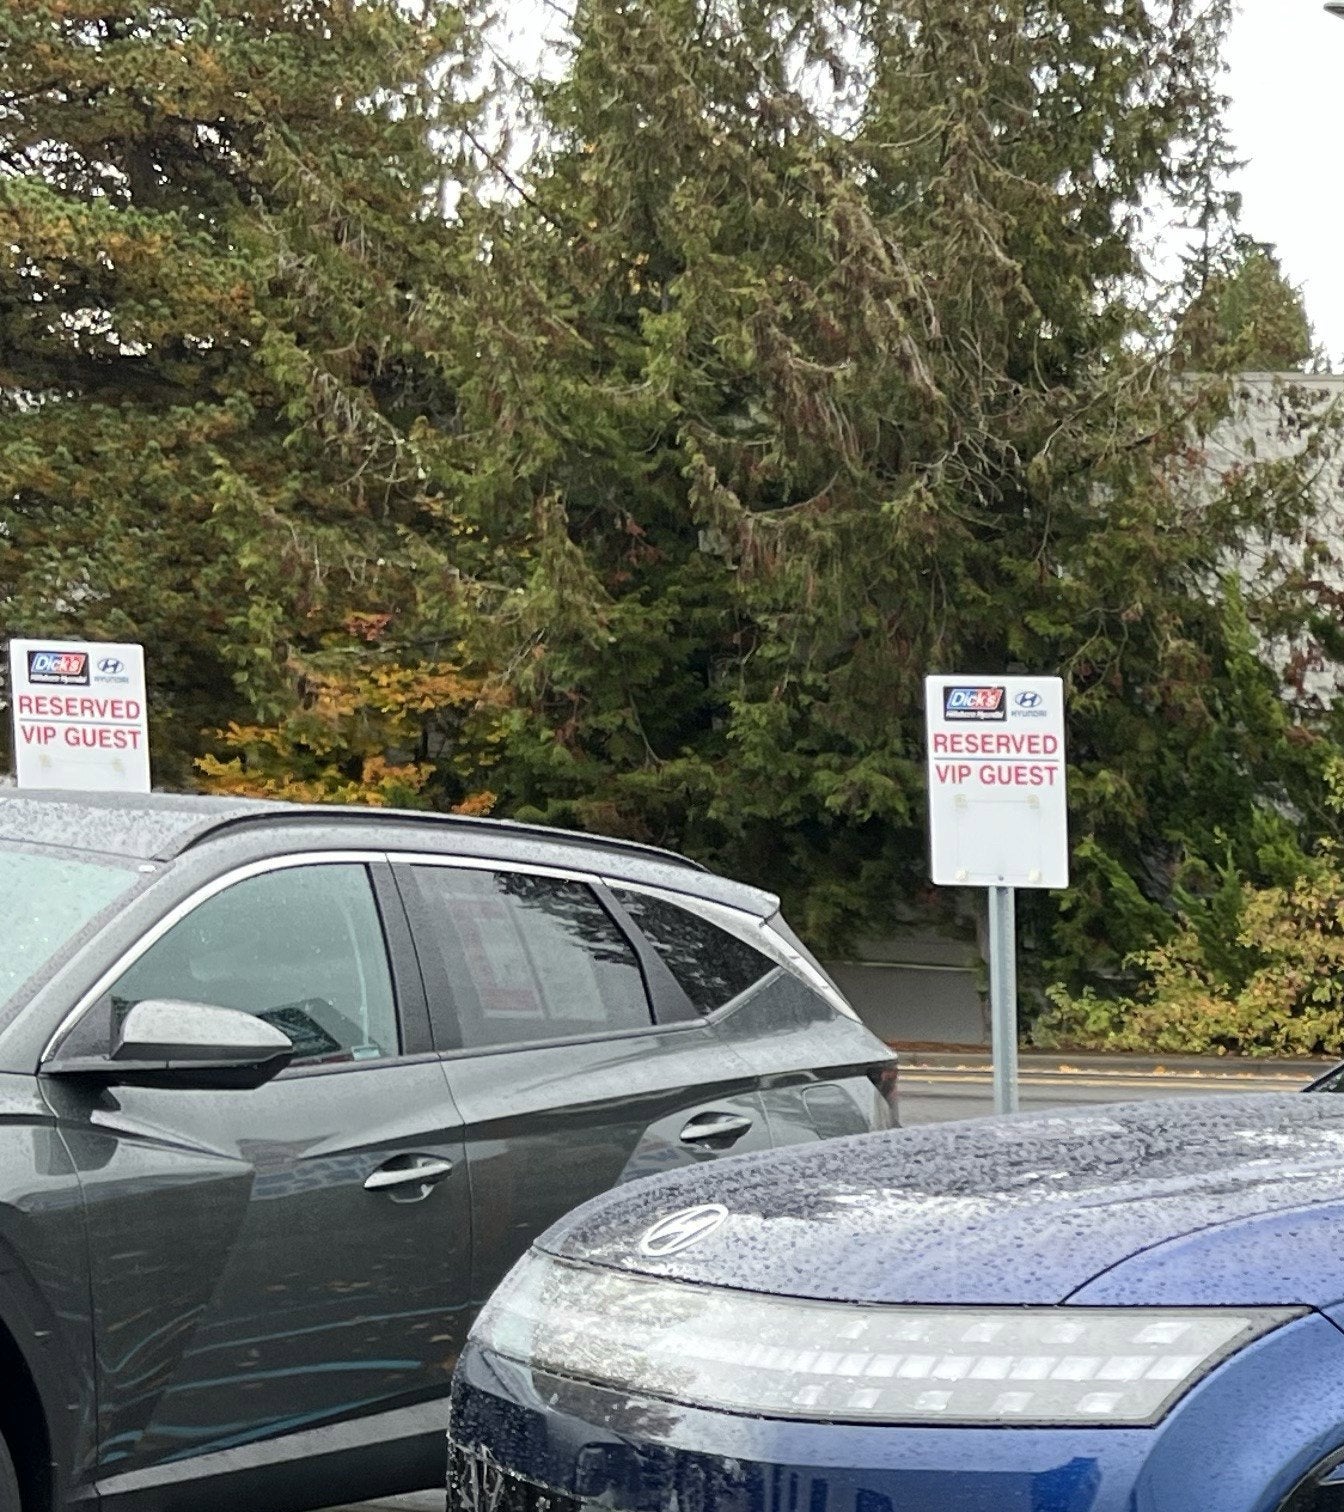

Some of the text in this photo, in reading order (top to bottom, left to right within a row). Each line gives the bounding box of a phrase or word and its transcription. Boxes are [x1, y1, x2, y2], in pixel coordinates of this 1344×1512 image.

[18, 695, 141, 720] RESERVED
[20, 725, 142, 749] VIP GUEST
[933, 733, 1058, 754] RESERVED
[935, 765, 1059, 786] VIP GUEST
